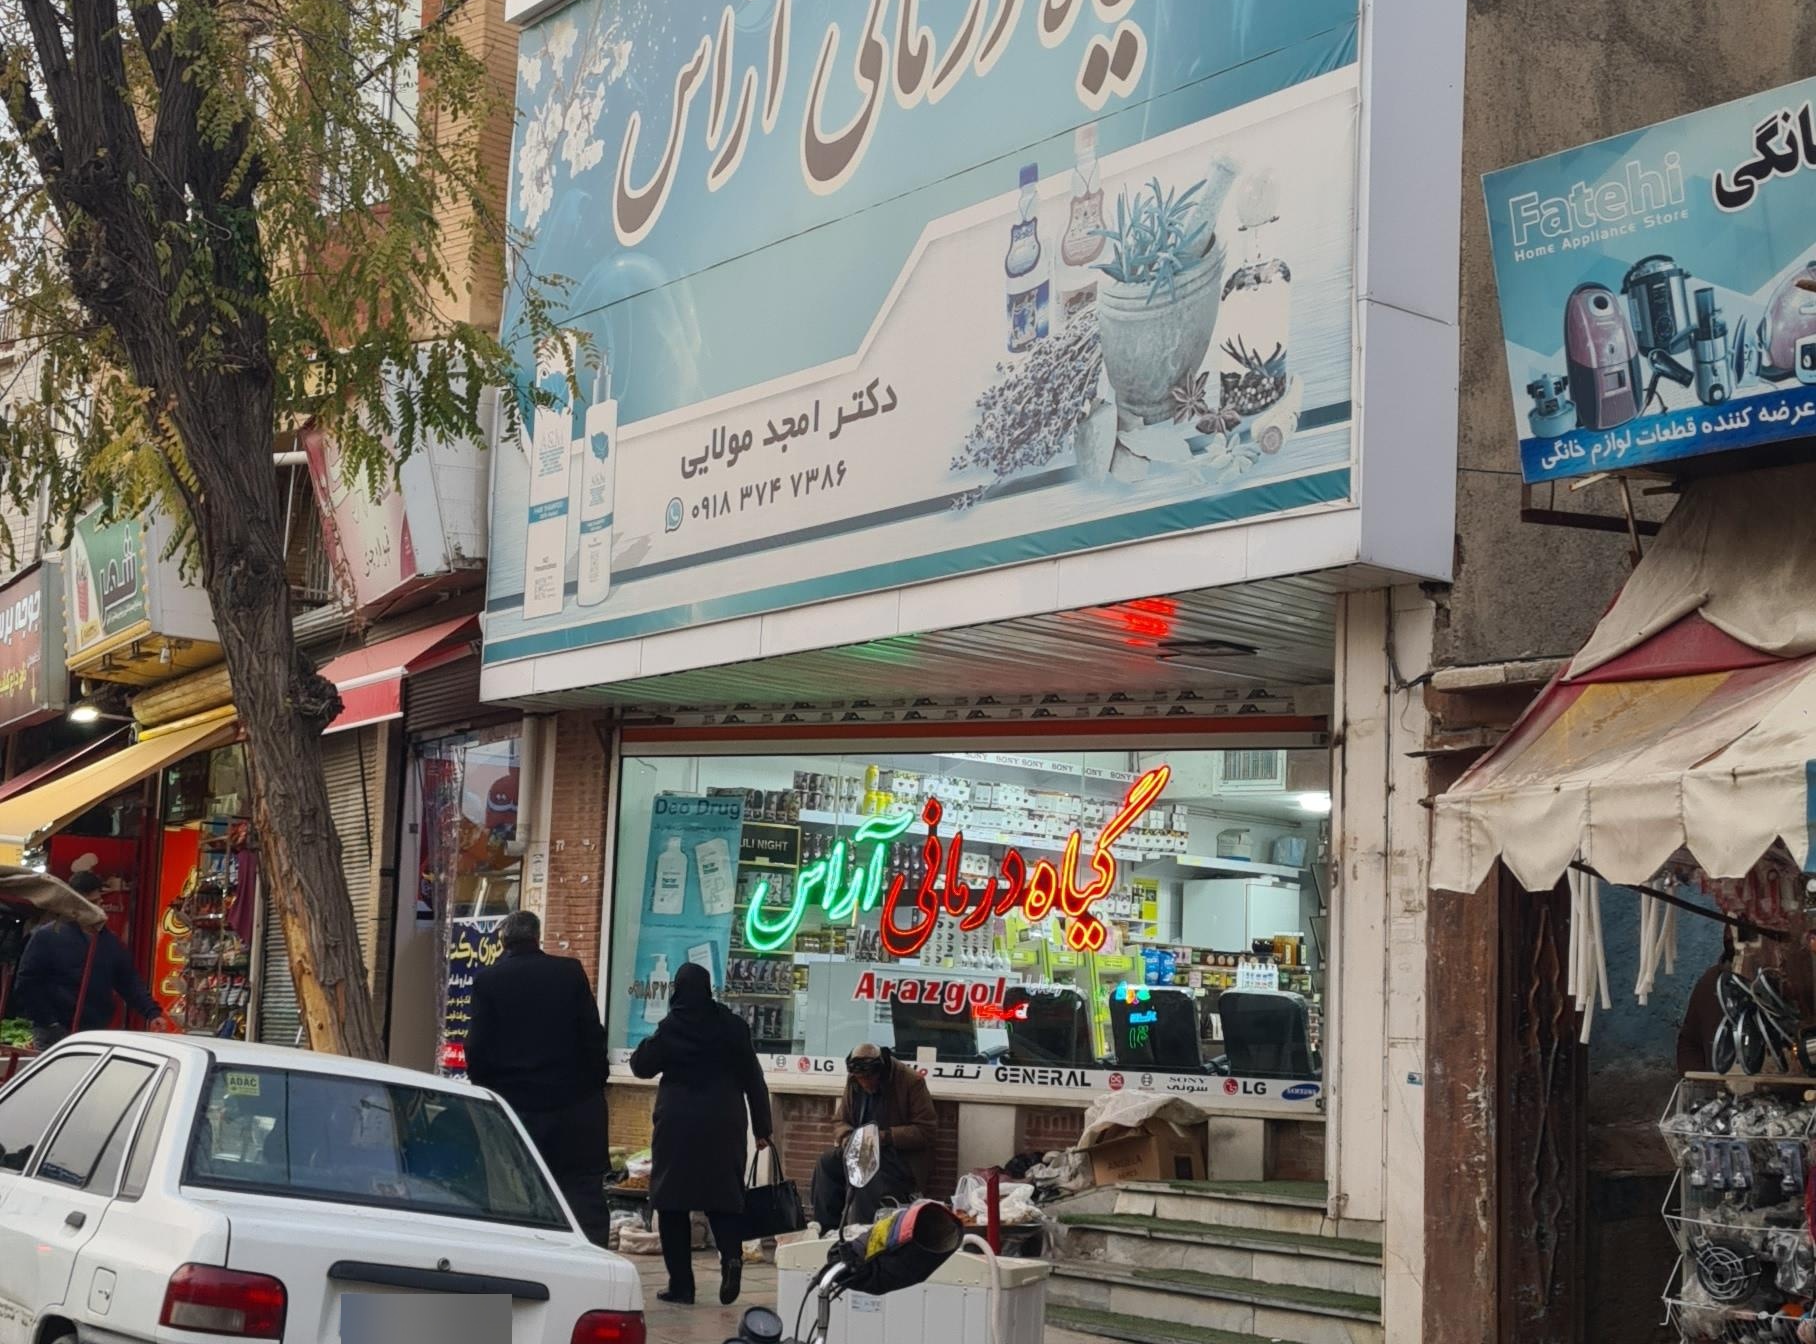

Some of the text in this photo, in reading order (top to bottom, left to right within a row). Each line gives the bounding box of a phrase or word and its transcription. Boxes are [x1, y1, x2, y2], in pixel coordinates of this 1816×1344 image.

[1714, 102, 1816, 208] انگی
[1508, 152, 1685, 247] Fatehi
[1514, 208, 1689, 262] Home Appliance Store
[681, 377, 898, 479] دکتر امجد مولایی
[1540, 399, 1816, 470] عرضه کننده قطعات لوازم خانگی
[691, 459, 847, 520] ۰۹۱۸ ۳۷۴ ۷۳۸۶
[14, 589, 41, 639] جوجه
[696, 799, 740, 820] Drug
[745, 763, 1171, 955] گیاه درمانی آراس
[757, 839, 788, 851] NIGHT
[852, 971, 1007, 1013] Arazgol
[229, 1076, 257, 1087] ADAC
[814, 1059, 834, 1072] LG
[932, 1064, 982, 1079] نقد
[994, 1066, 1092, 1088] GENERAL
[1169, 1075, 1205, 1084] SONY
[1166, 1083, 1209, 1094] سونی
[1242, 1082, 1267, 1095] LG
